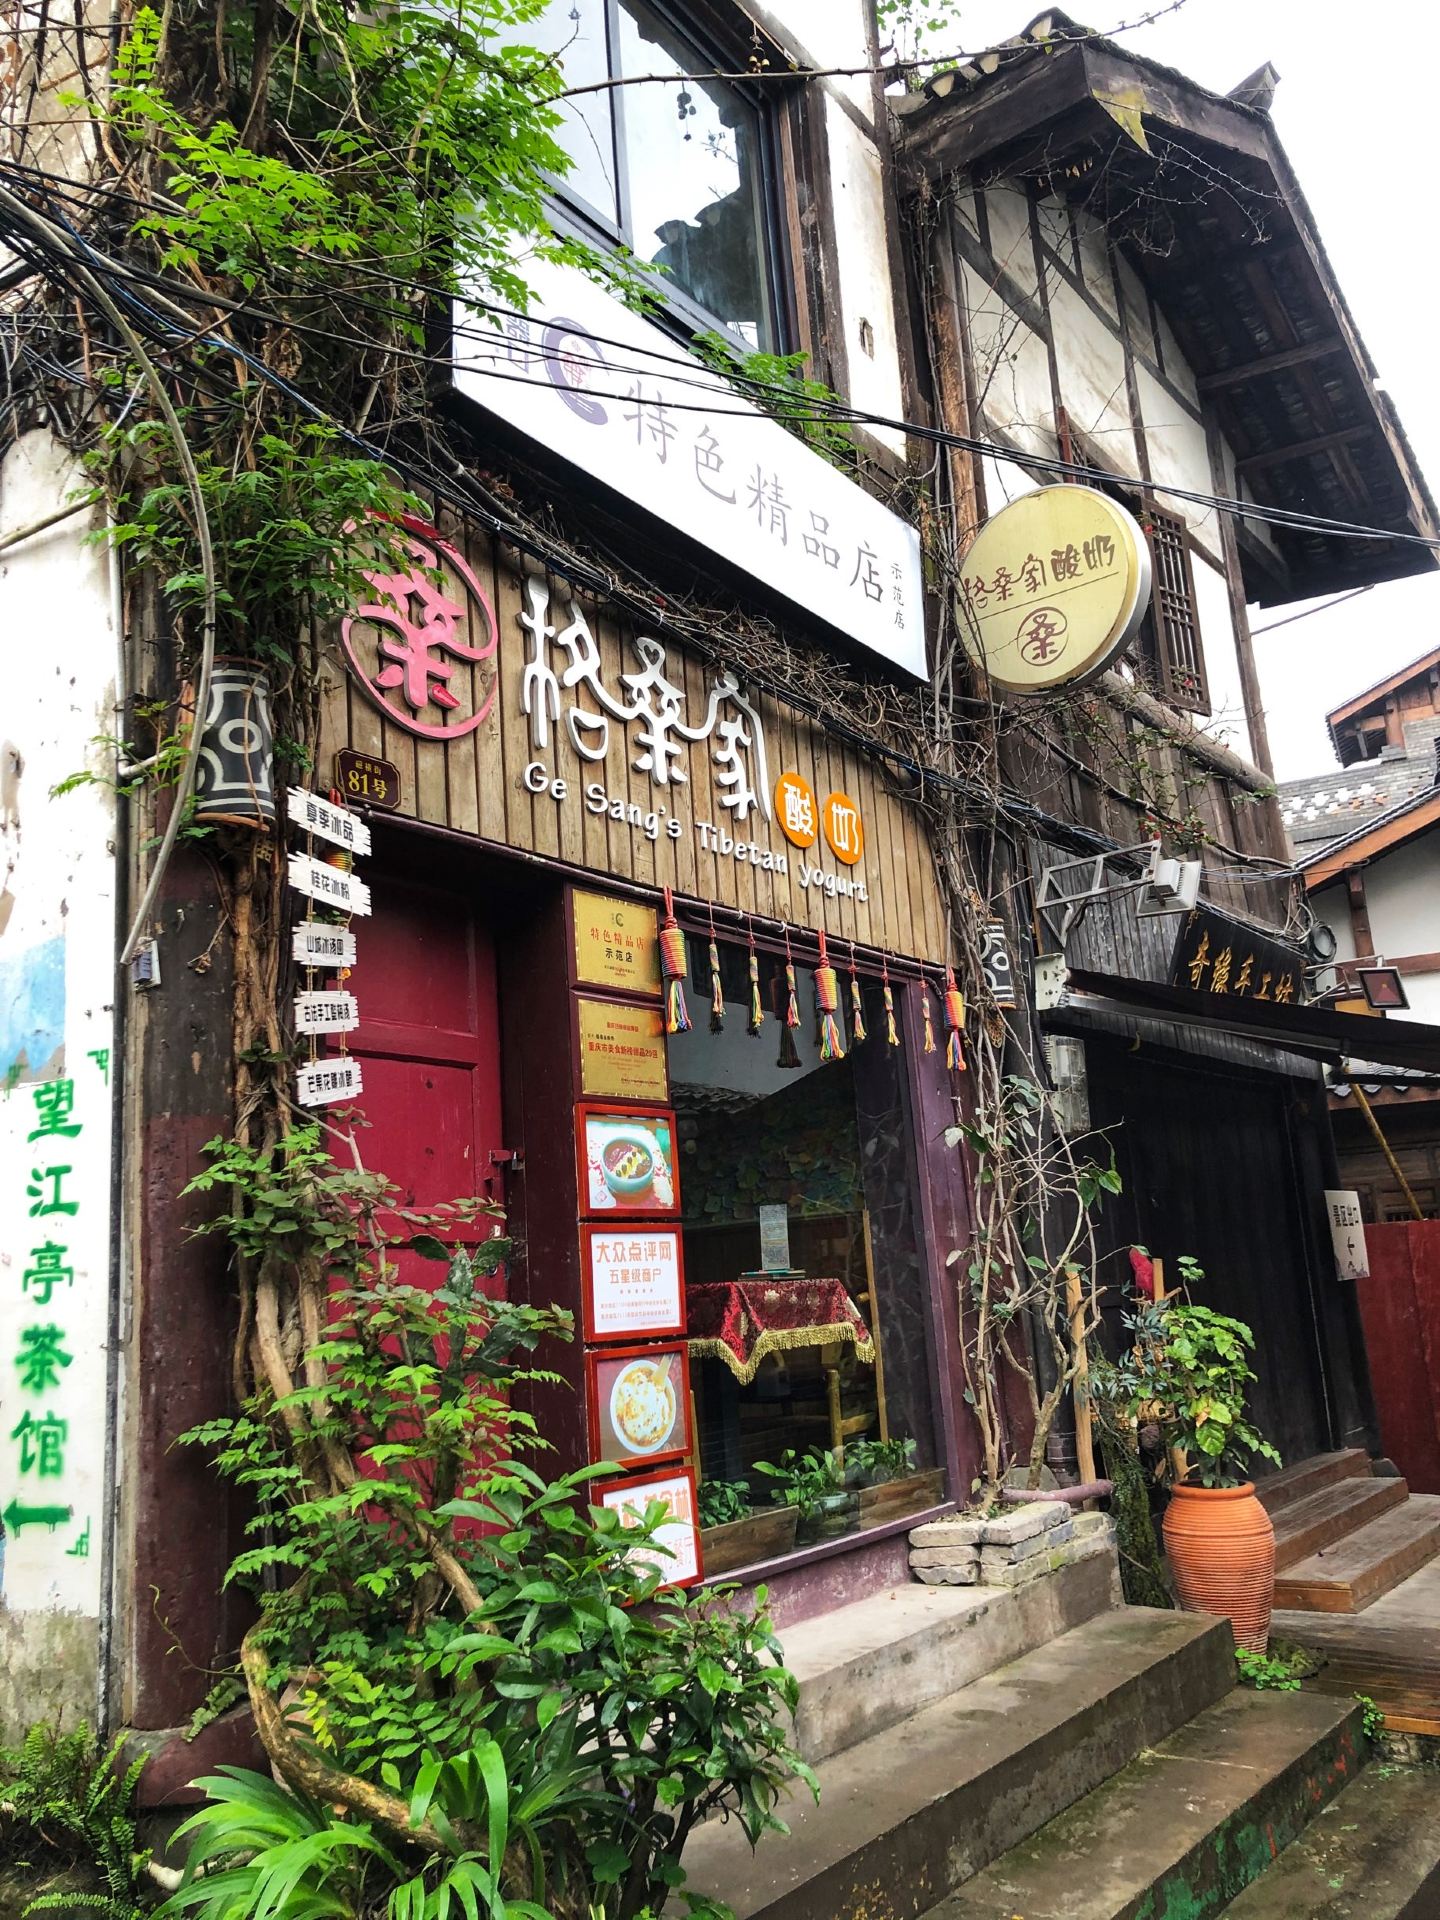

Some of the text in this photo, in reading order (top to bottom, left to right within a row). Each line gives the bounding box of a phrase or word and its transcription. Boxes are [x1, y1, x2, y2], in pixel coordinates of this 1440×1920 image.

[624, 379, 886, 605] 特色精品店
[890, 562, 906, 630] 示范店
[348, 769, 388, 800] 81号
[306, 801, 354, 843] 夏季冰品
[523, 761, 869, 902] Ge Sang's Tibetan yogurt
[311, 869, 351, 901] 桂花冰粉
[306, 935, 345, 956] 山城冰汤圆
[590, 927, 645, 950] 特色精品店
[605, 947, 633, 963] 示范店
[596, 1240, 672, 1263] 大众点评网
[11, 1077, 83, 1478] 望江亭茶馆
[609, 1268, 662, 1284] 五星级商户
